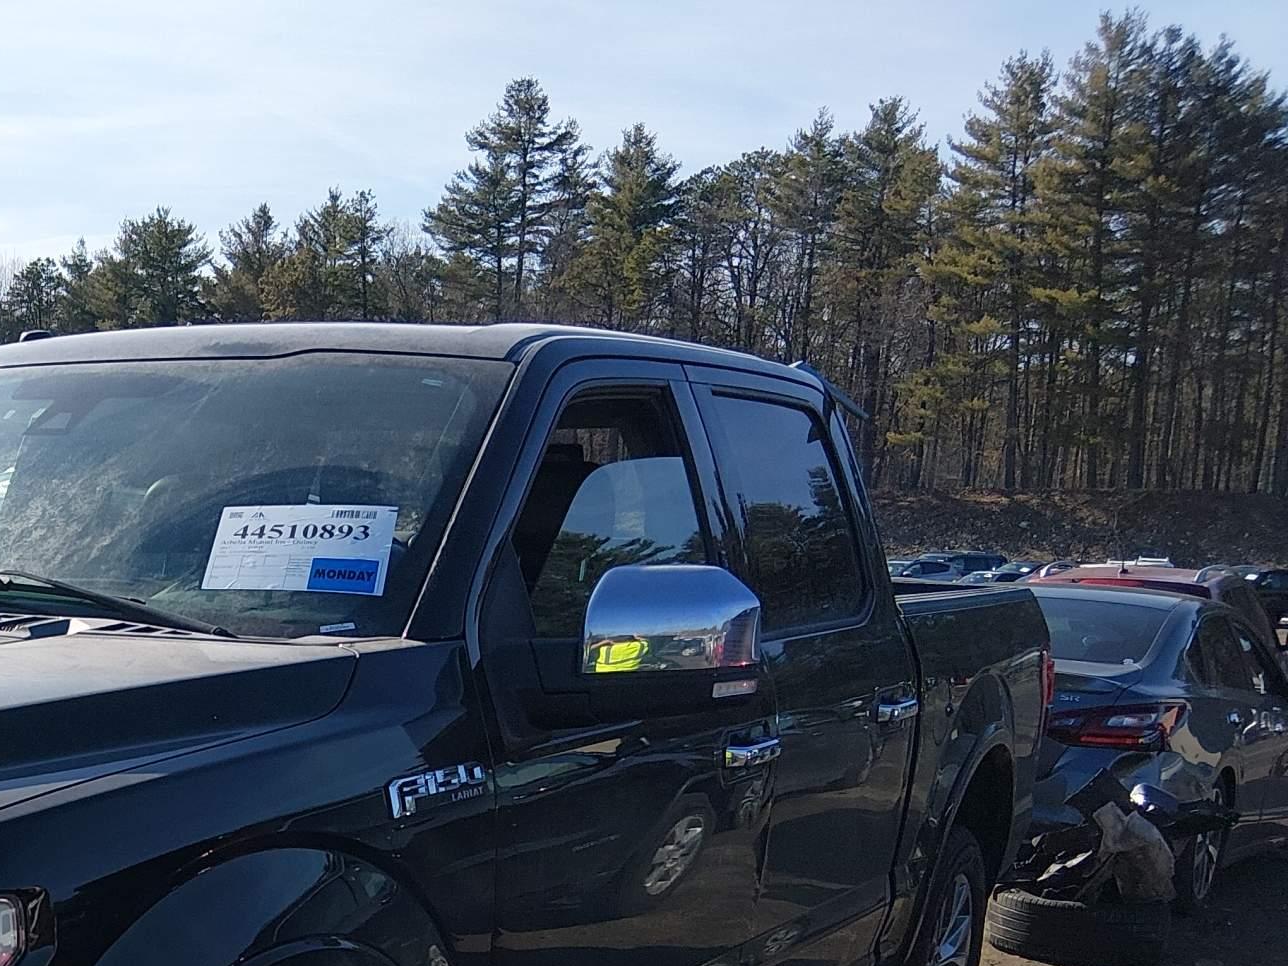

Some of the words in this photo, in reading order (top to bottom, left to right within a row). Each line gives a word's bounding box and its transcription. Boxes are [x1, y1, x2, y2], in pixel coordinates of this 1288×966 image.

[232, 523, 371, 541] 44510893
[313, 568, 375, 582] MONDAY
[451, 786, 484, 802] LARIAT
